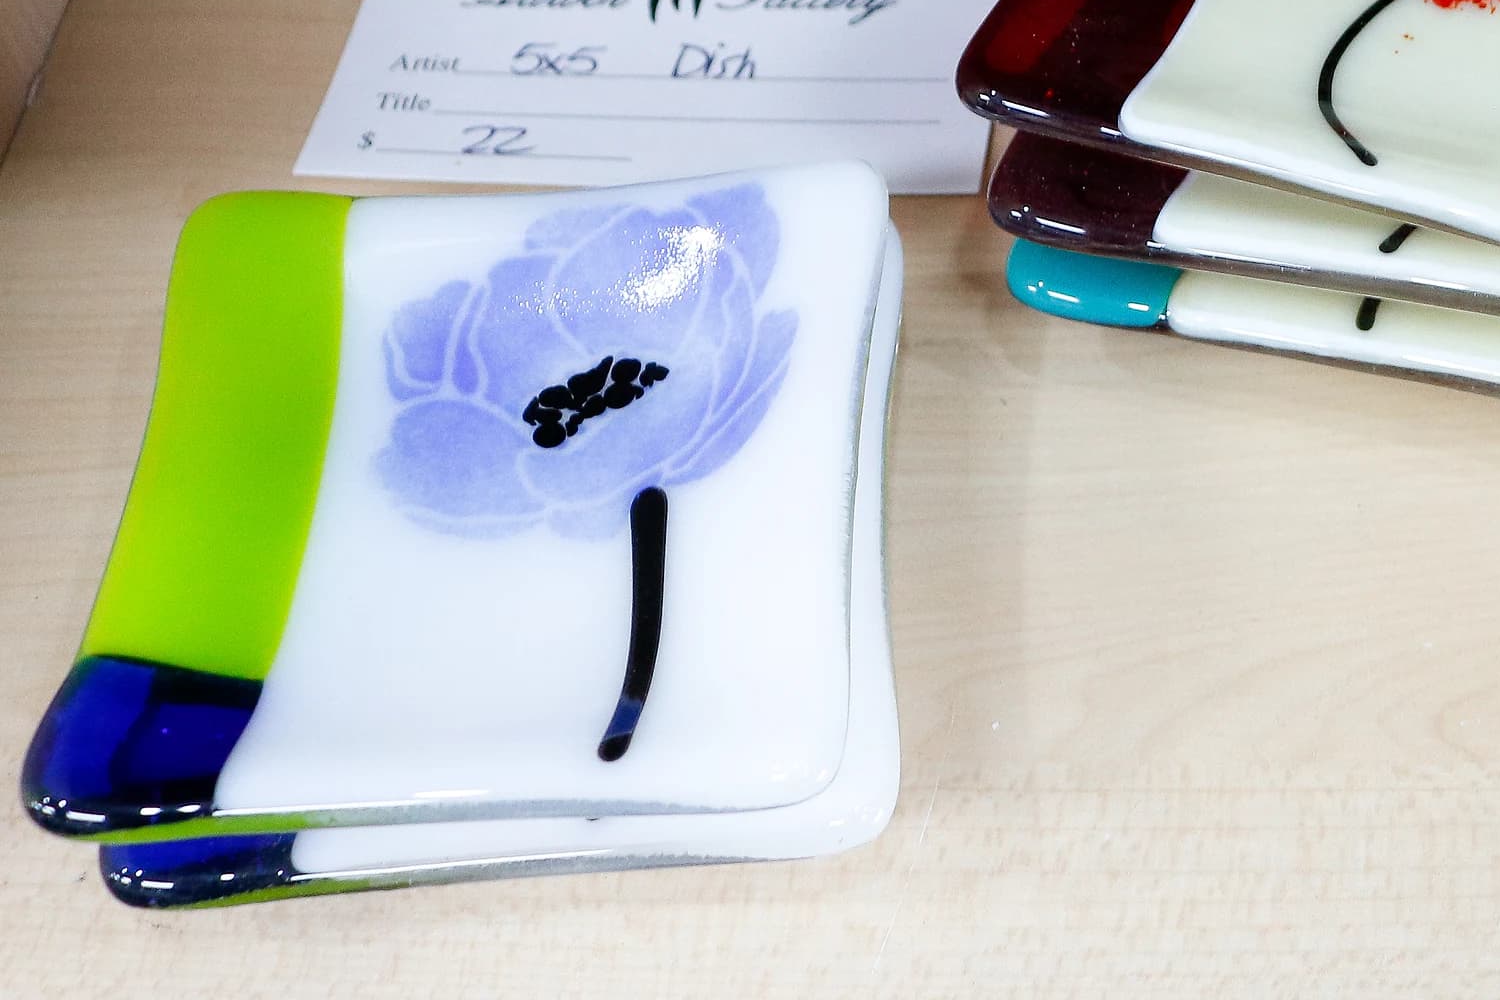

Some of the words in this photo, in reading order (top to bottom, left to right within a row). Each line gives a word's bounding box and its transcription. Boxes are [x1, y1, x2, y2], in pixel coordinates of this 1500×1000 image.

[390, 52, 459, 73] Artist
[511, 41, 607, 77] 5x5
[671, 43, 758, 81] Dish
[377, 92, 430, 113] Title
[358, 129, 375, 152] $
[459, 125, 537, 156] 22
